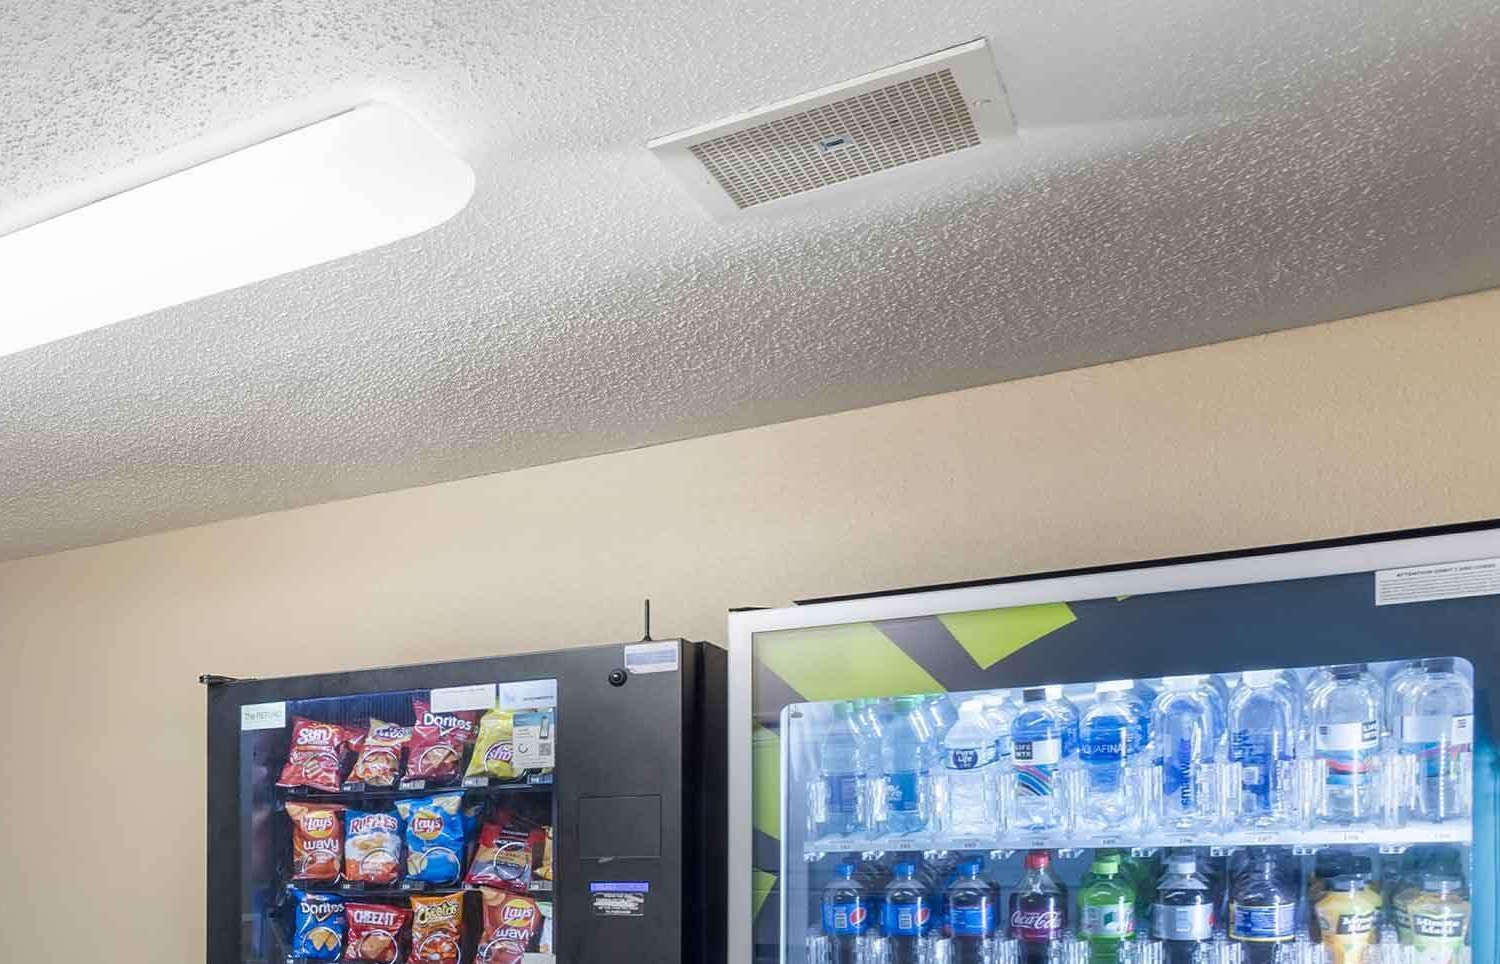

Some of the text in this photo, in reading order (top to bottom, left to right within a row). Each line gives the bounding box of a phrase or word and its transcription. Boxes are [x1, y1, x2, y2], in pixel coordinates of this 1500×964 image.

[423, 712, 472, 731] Doritos
[303, 839, 339, 852] wavy
[299, 902, 345, 914] Doritos
